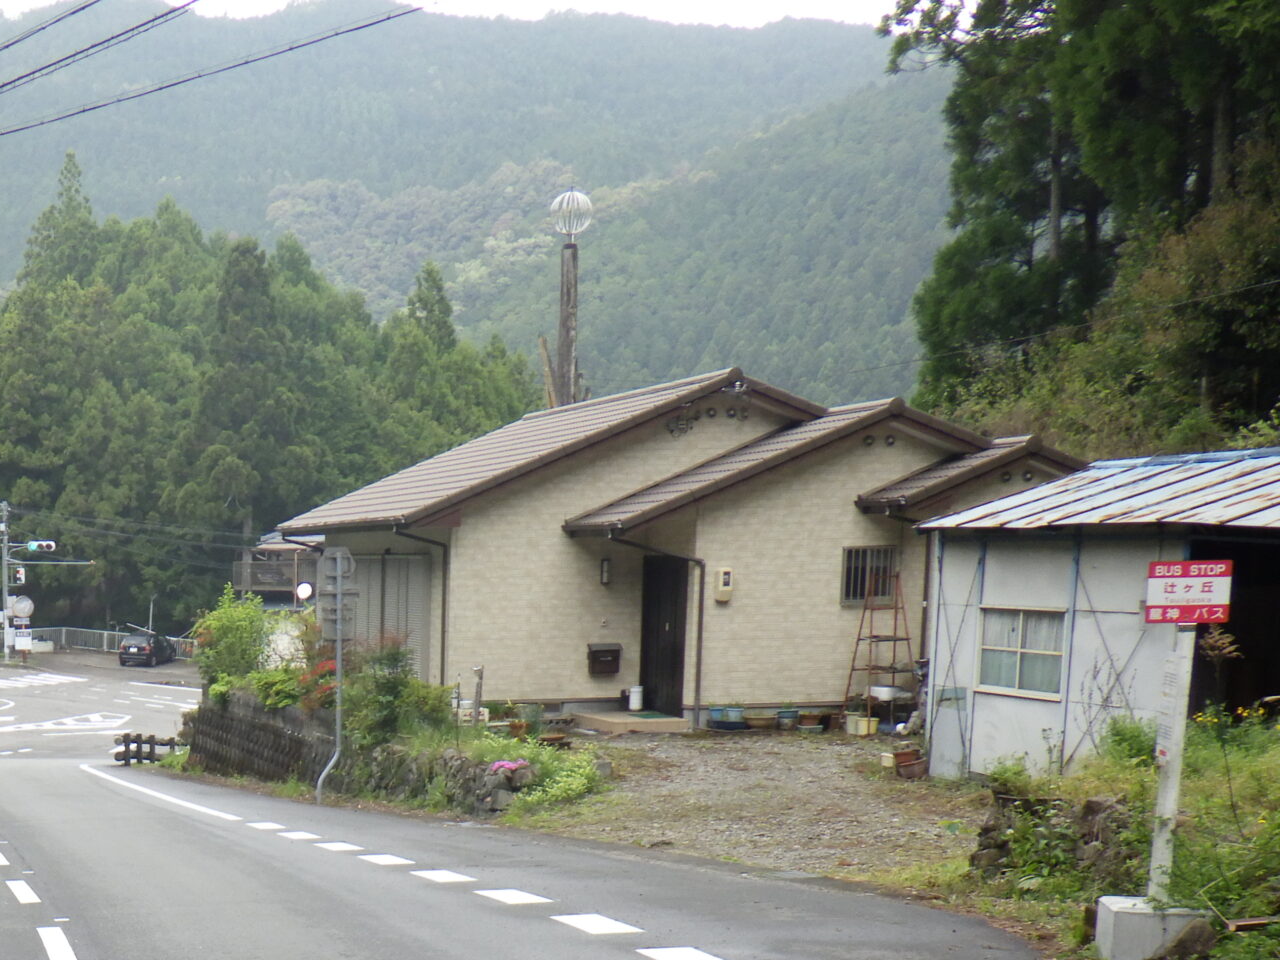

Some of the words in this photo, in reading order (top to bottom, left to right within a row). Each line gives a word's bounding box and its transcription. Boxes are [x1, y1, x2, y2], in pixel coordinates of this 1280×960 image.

[1155, 565, 1183, 576] BUS
[1189, 564, 1226, 576] STOP
[1193, 607, 1225, 620] バス
